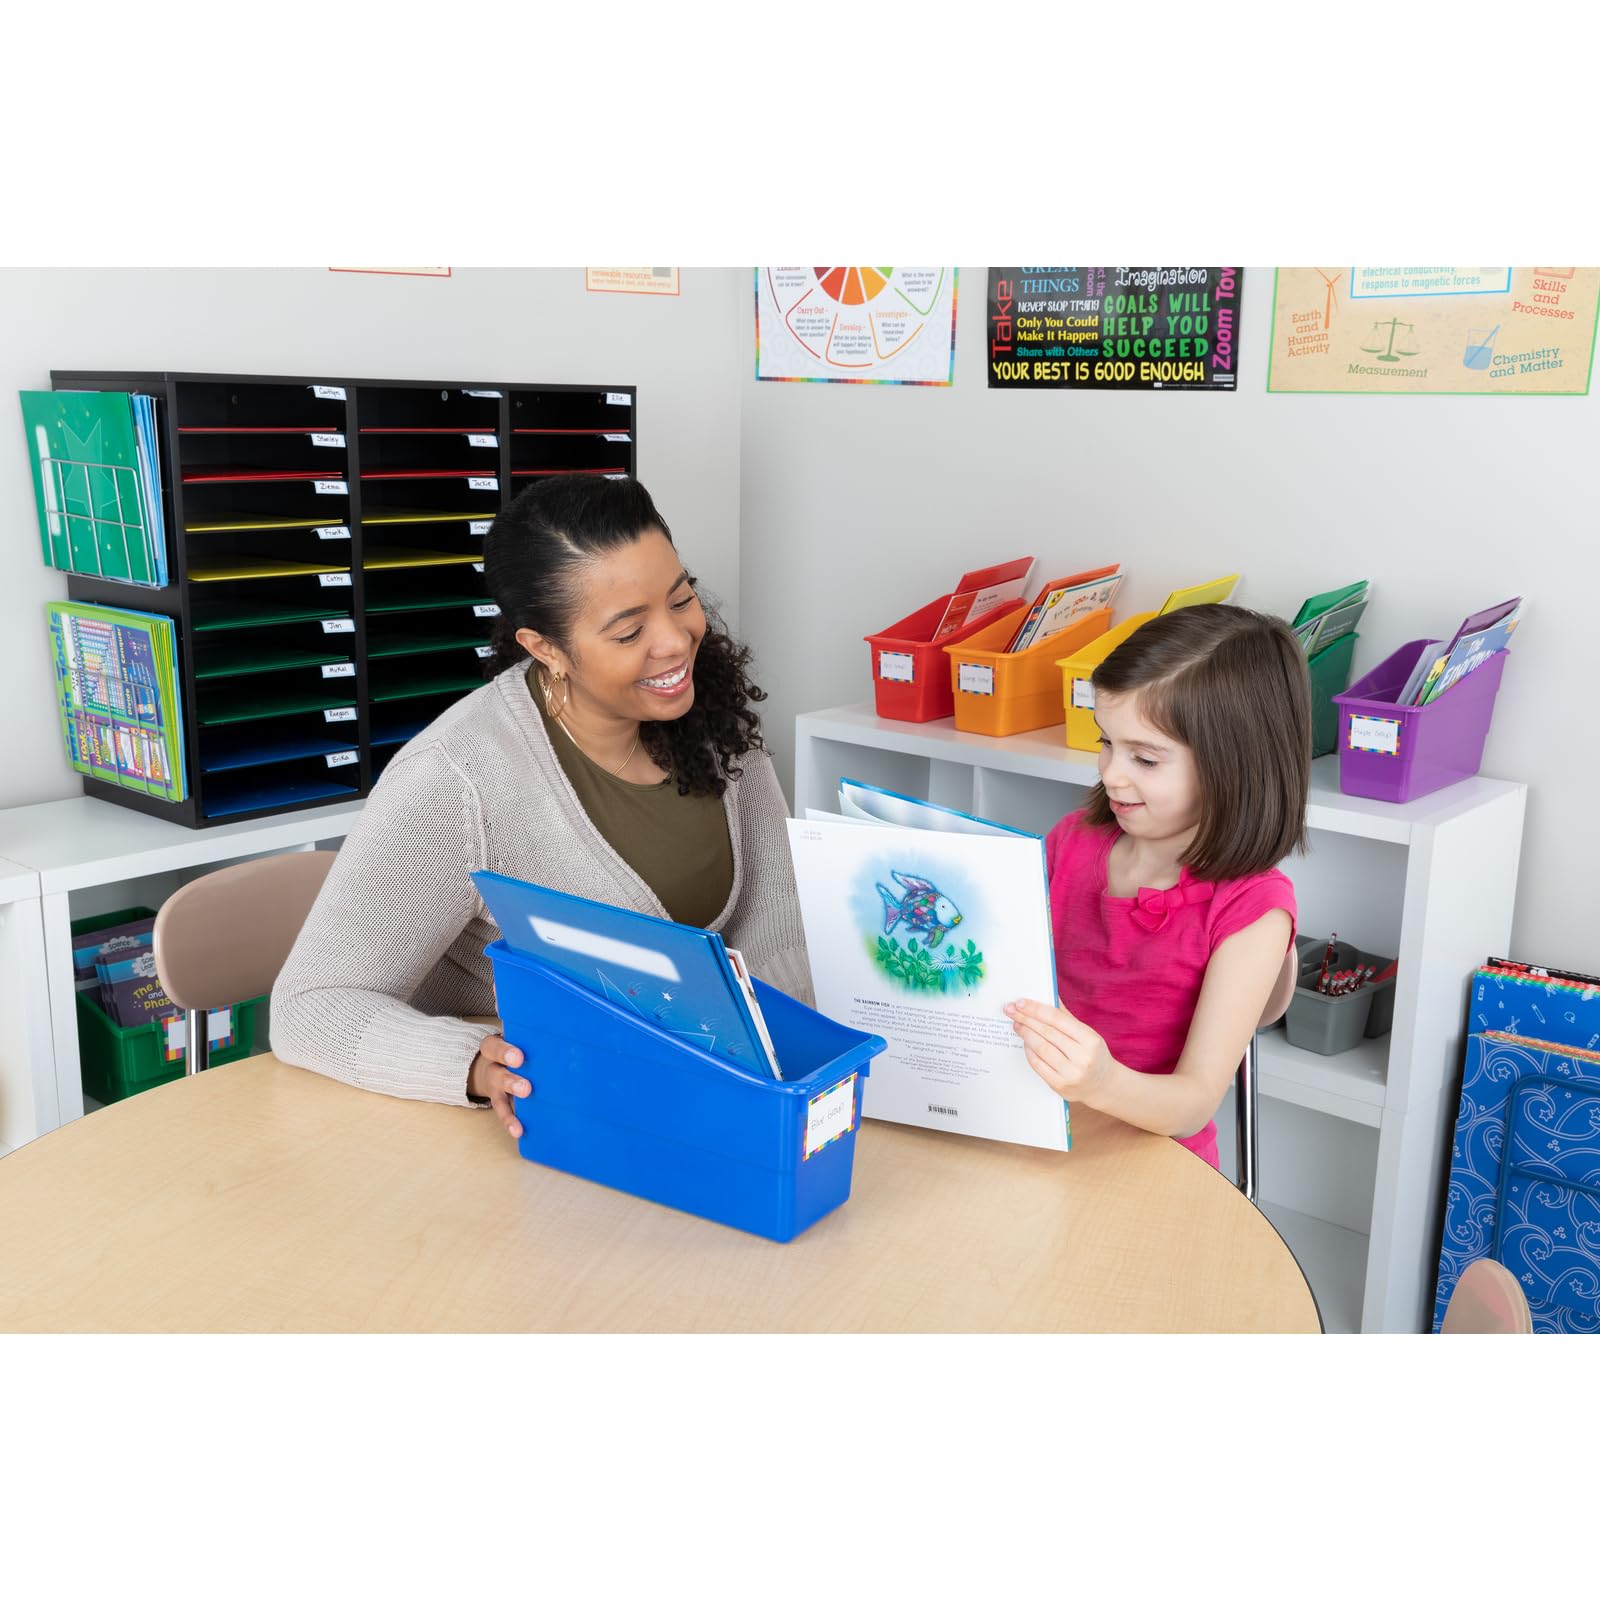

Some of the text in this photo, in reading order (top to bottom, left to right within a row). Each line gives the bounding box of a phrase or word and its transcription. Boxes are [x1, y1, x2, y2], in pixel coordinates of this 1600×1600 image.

[1020, 278, 1079, 293] THINGS
[1115, 267, 1208, 292] Imagination
[1362, 276, 1480, 290] response to magnetic forces
[1533, 279, 1567, 293] Skills
[1104, 292, 1212, 314] GOALS WILL
[1533, 294, 1560, 304] and
[1292, 310, 1322, 324] Earth
[1512, 302, 1575, 320] Processes
[992, 280, 1013, 358] Take
[1016, 315, 1099, 330] Only You Could
[1103, 316, 1209, 336] HELP YOU
[1296, 322, 1318, 334] and
[1016, 330, 1098, 344] Make It Happen
[1212, 308, 1232, 370] Zoom
[1288, 332, 1328, 346] Human
[1016, 347, 1099, 357] Share with Others
[1102, 338, 1209, 358] SUCCEED
[1288, 344, 1330, 358] Activity
[1492, 348, 1560, 366] Chemistry
[993, 362, 1030, 380] YOUR
[1034, 362, 1071, 380] BEST
[1075, 362, 1089, 380] IS
[1095, 362, 1135, 381] GOOD
[1140, 361, 1205, 381] ENOUGH
[1347, 364, 1428, 378] Measurement
[1490, 359, 1564, 378] and Matter
[133, 983, 153, 999] The
[148, 990, 163, 999] and
[144, 997, 171, 1010] phas
